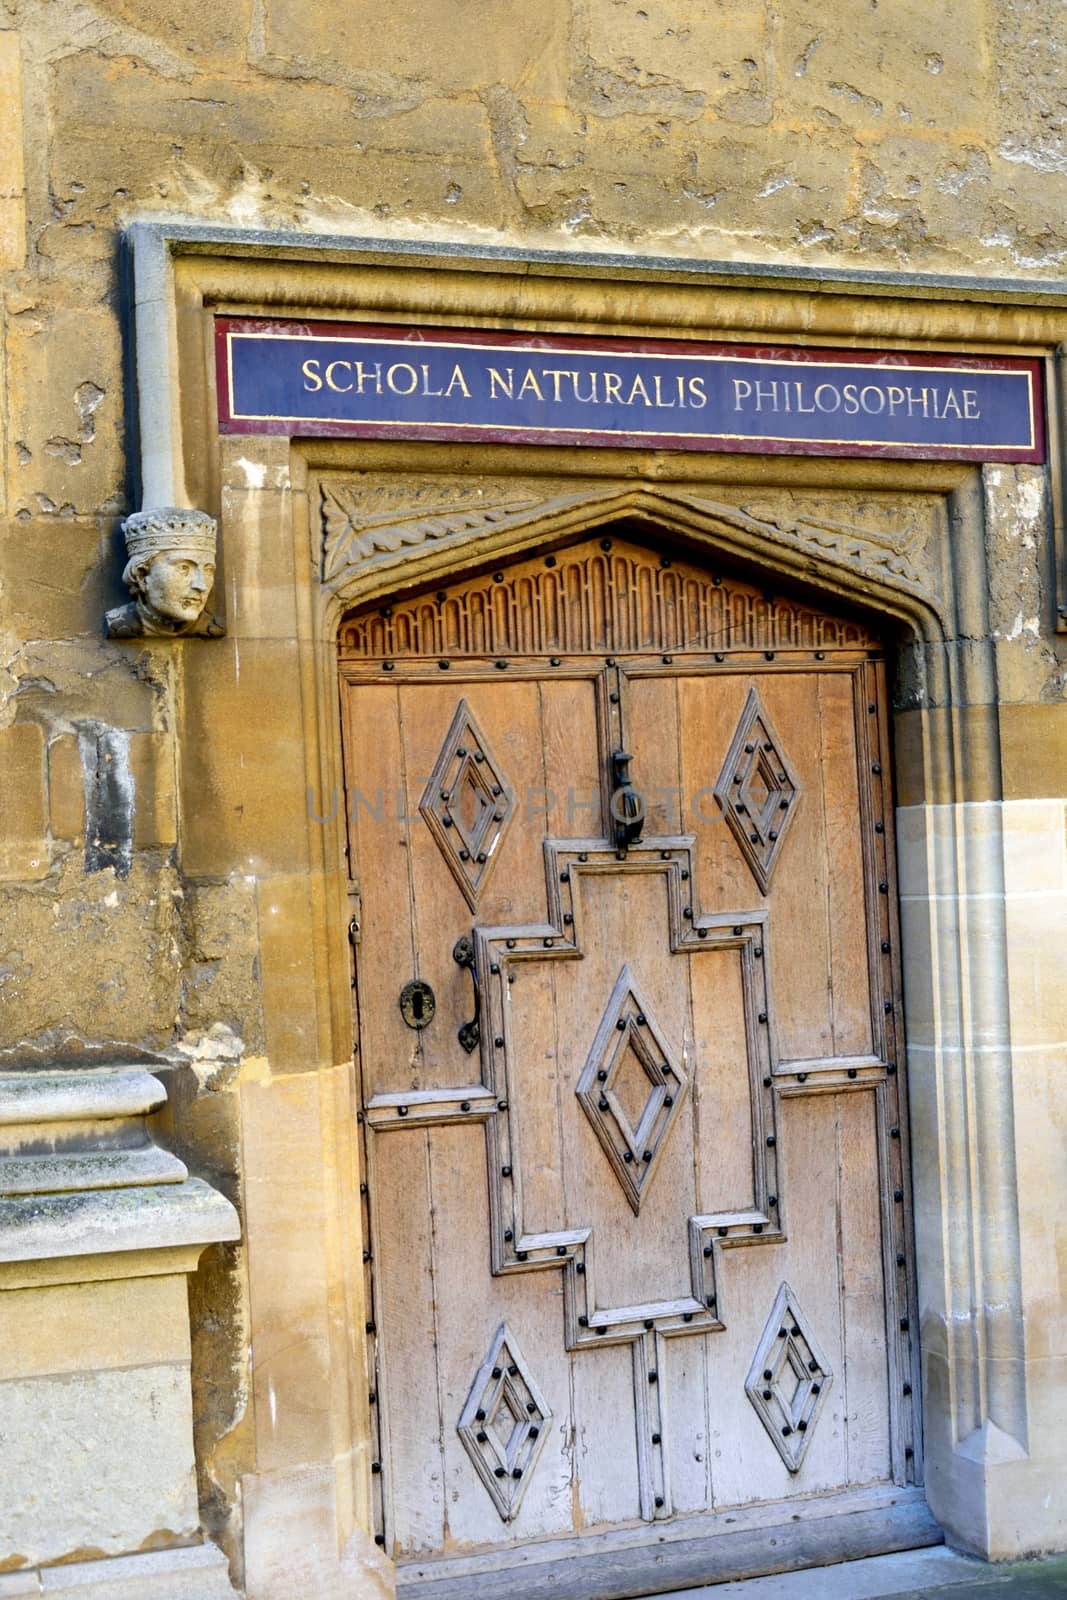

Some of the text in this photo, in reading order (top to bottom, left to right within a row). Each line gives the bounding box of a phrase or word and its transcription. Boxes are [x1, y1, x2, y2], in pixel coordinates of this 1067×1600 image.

[301, 358, 981, 420] SCHOLA NATURALIS PHILOSOPHIAE
